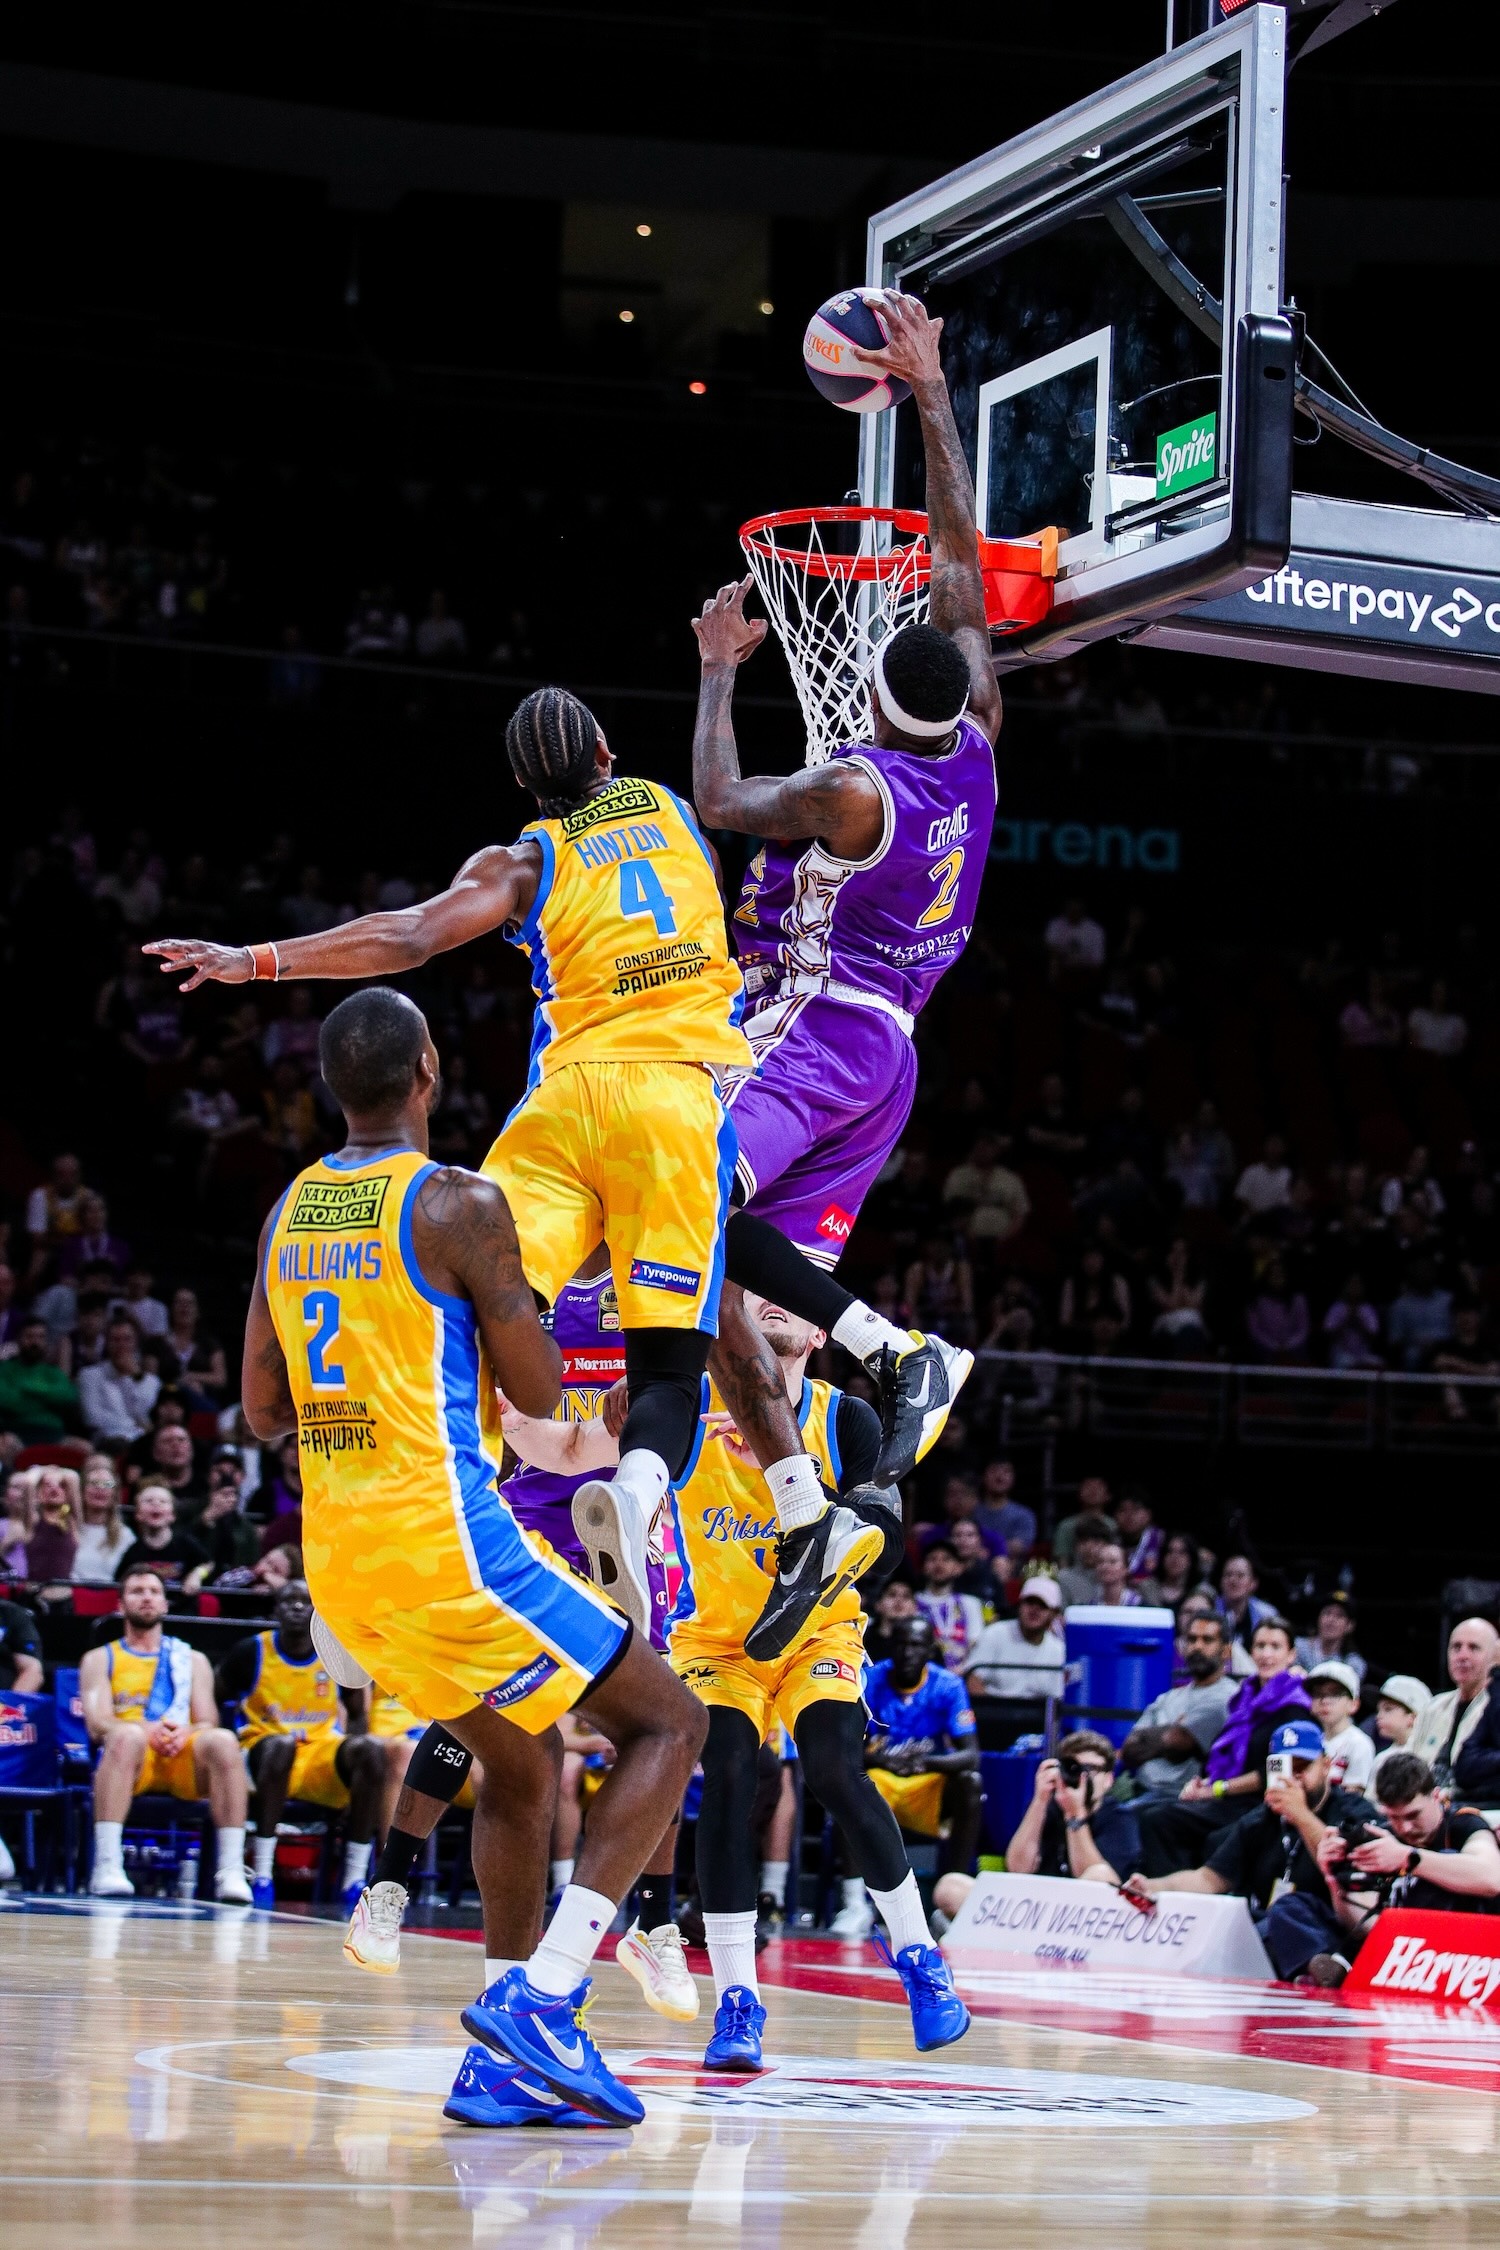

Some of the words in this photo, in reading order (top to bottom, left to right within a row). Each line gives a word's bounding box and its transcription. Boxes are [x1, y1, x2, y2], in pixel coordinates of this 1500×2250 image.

[1157, 427, 1215, 487] Sprite
[1245, 565, 1433, 633] afterpay
[569, 791, 648, 832] STORAGE
[927, 802, 968, 852] CRAIG
[574, 823, 669, 869] HINTON
[990, 820, 1182, 873] arena
[619, 859, 679, 940] 4
[915, 845, 965, 930] 2
[615, 942, 704, 971] CONSTRUCTION
[295, 1202, 373, 1224] STORAGE
[301, 1182, 381, 1203] NATIONAL
[280, 1241, 382, 1282] WILLIAMS
[642, 1265, 697, 1286] Tyrepower
[567, 1295, 593, 1303] OPTUS
[303, 1290, 347, 1391] 2
[492, 1658, 549, 1700] Tyrepower
[687, 1678, 721, 1691] niSC
[816, 1664, 834, 1674] NBL
[433, 1743, 466, 1767] 1:50
[972, 1895, 1044, 1930] SALON
[1047, 1903, 1197, 1947] WAREHOUSE
[1370, 1935, 1500, 2009] Harvey
[635, 2089, 1197, 2106] ITSUBISHI
